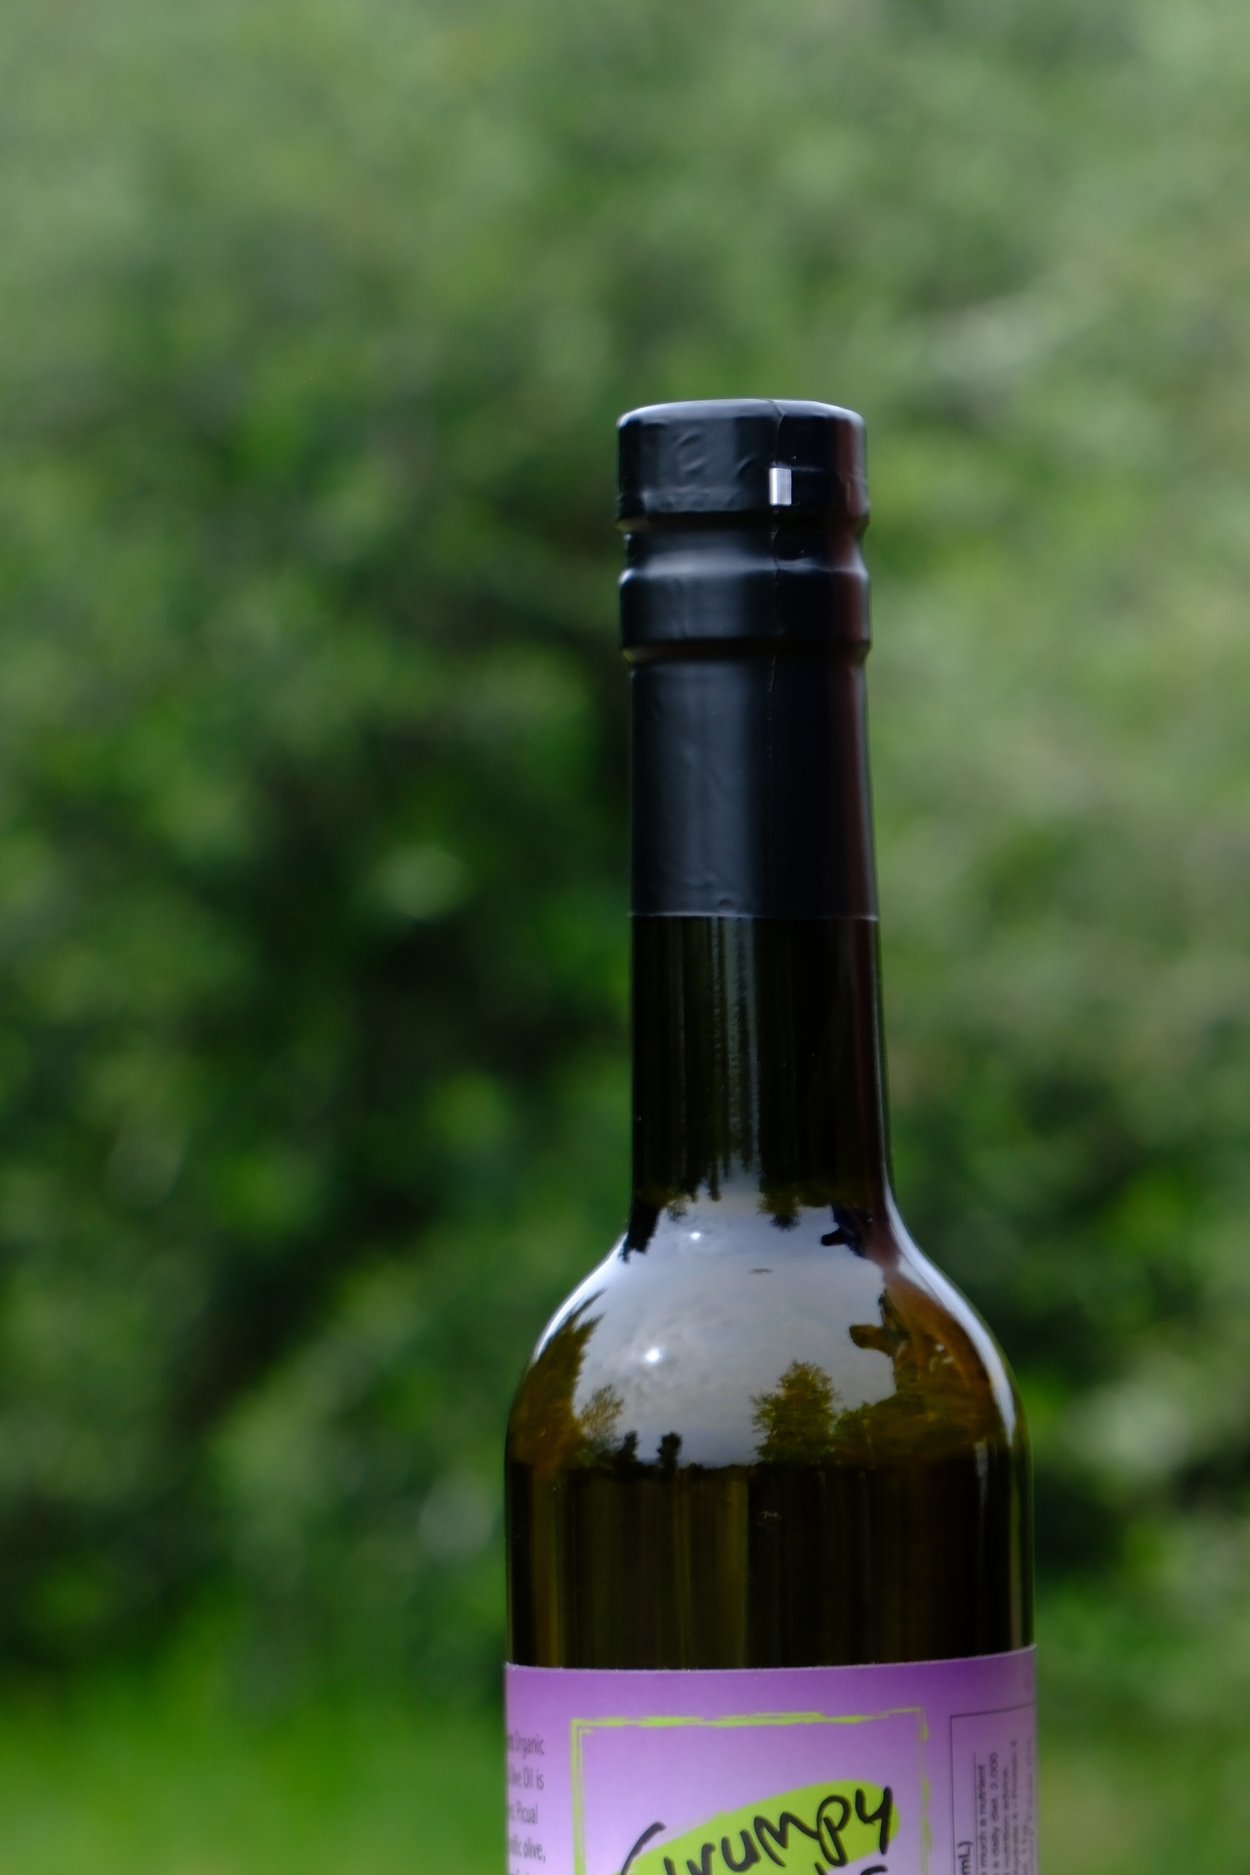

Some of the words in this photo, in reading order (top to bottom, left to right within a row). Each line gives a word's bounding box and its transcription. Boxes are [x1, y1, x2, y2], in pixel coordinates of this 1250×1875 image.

[536, 1770, 544, 1790] is
[516, 1801, 538, 1824] Picual
[523, 1841, 546, 1862] olive,
